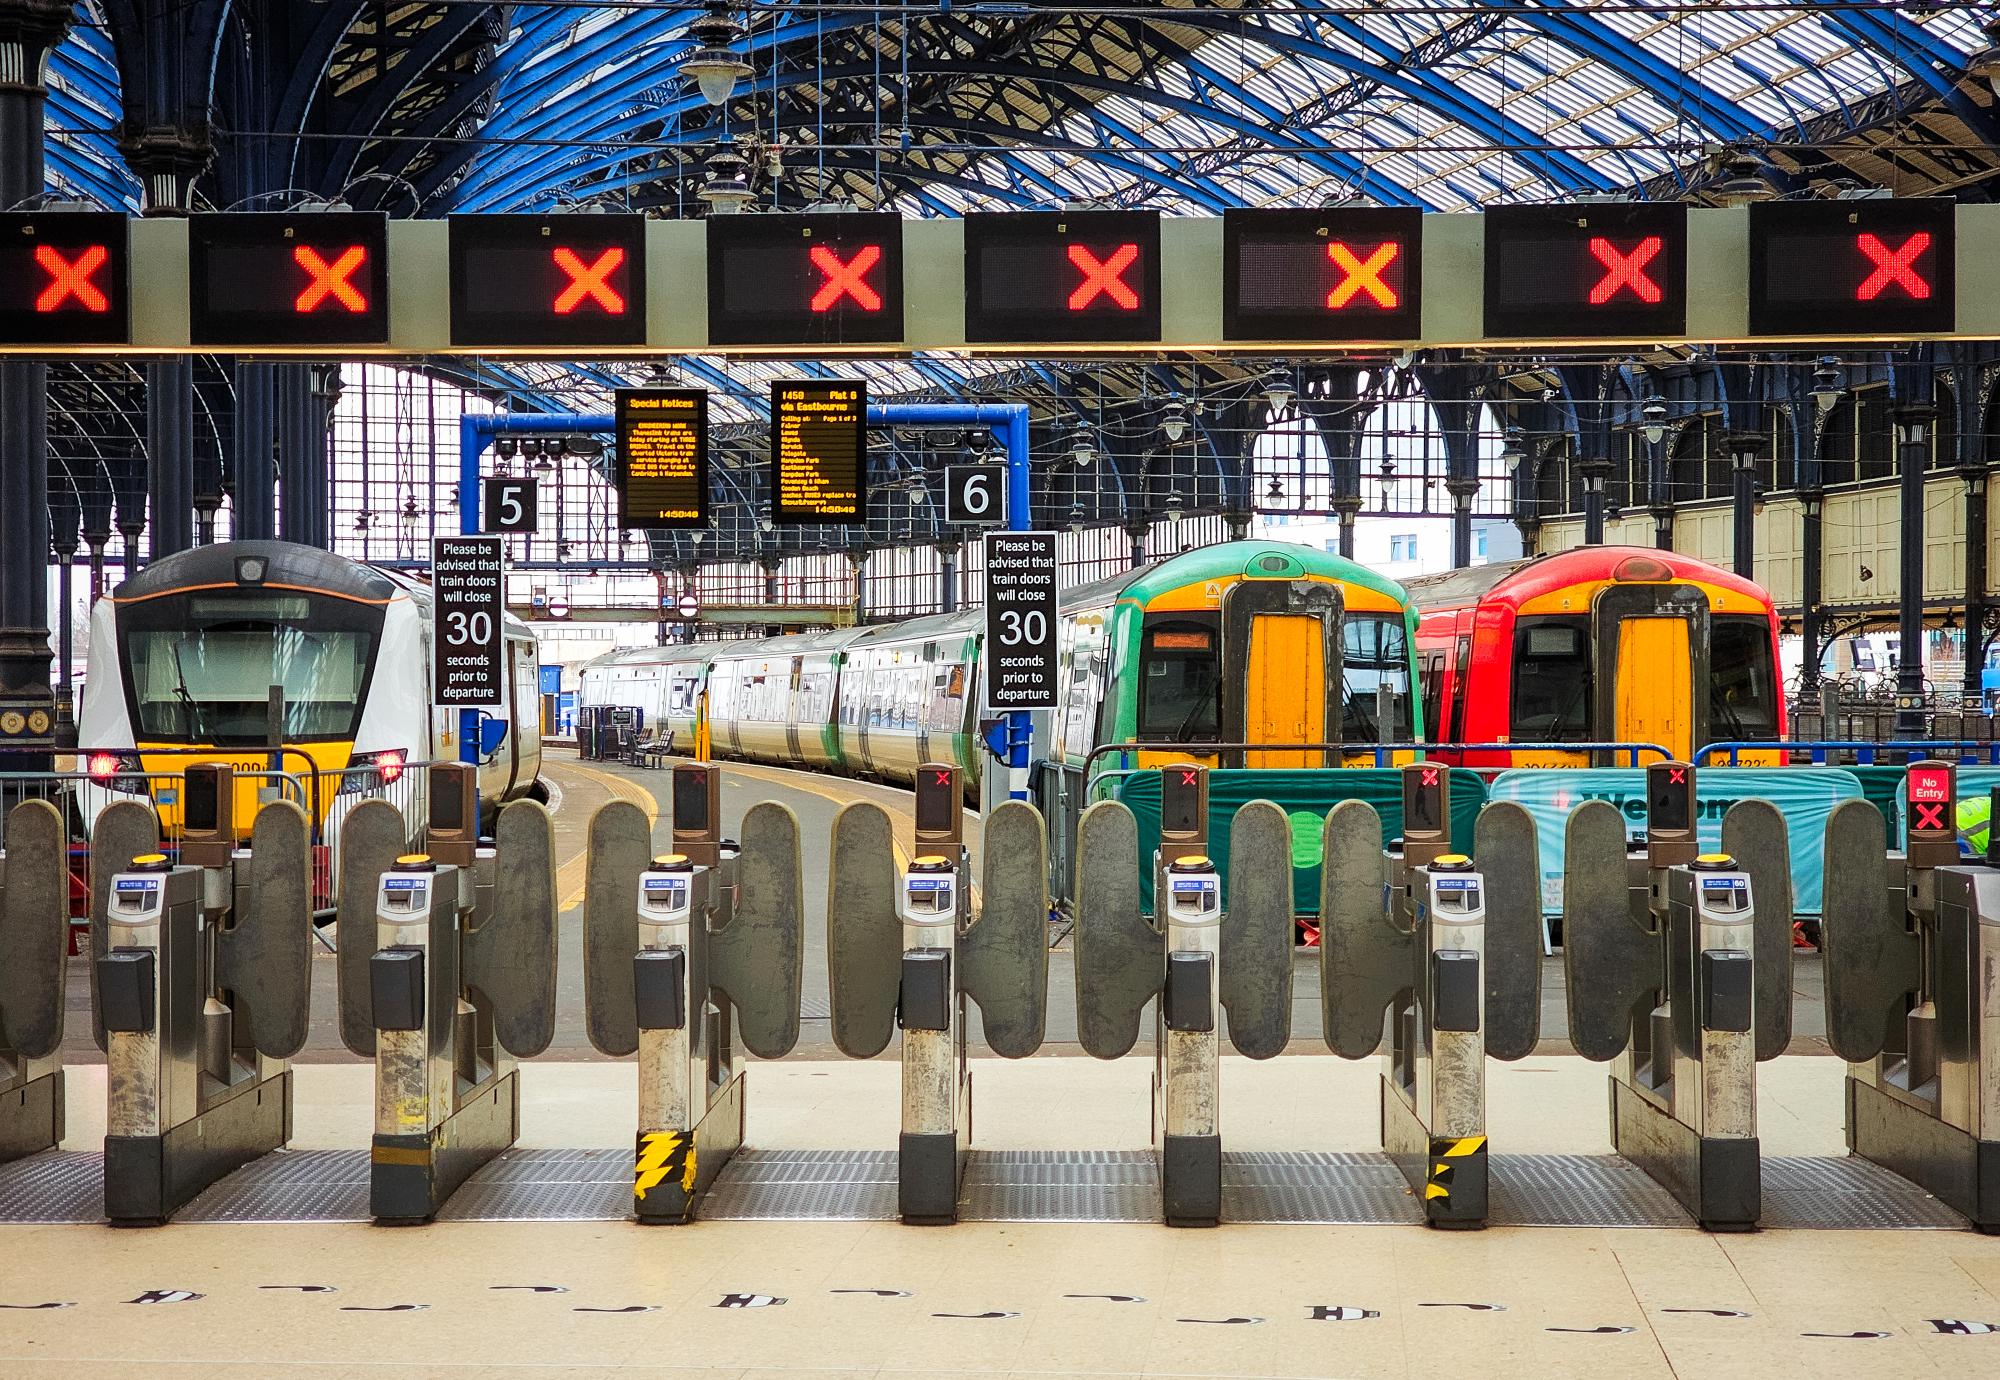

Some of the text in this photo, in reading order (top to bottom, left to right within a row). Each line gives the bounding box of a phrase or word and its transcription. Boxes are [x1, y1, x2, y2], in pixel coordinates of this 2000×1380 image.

[830, 391, 847, 400] Plat
[850, 391, 857, 400] 6
[630, 399, 694, 408] Special Notices
[780, 402, 848, 410] via Eastbourne
[963, 474, 989, 514] 6
[500, 487, 522, 525] 5
[443, 543, 491, 555] Please be
[995, 540, 1046, 552] Please be
[437, 559, 500, 571] advised that
[988, 556, 1054, 568] advised that
[440, 575, 496, 586] train doors
[992, 573, 1051, 584] train doors
[444, 591, 492, 602] will close
[997, 589, 1046, 601] will close
[446, 612, 492, 645] 30
[1000, 610, 1047, 645] 30
[447, 654, 490, 666] seconds
[1000, 654, 1044, 667] seconds
[449, 670, 488, 684] prior to
[1003, 672, 1043, 686] prior to
[443, 686, 494, 700] departure
[997, 688, 1050, 702] departure
[1922, 778, 1937, 788] No
[1916, 788, 1944, 800] Entry
